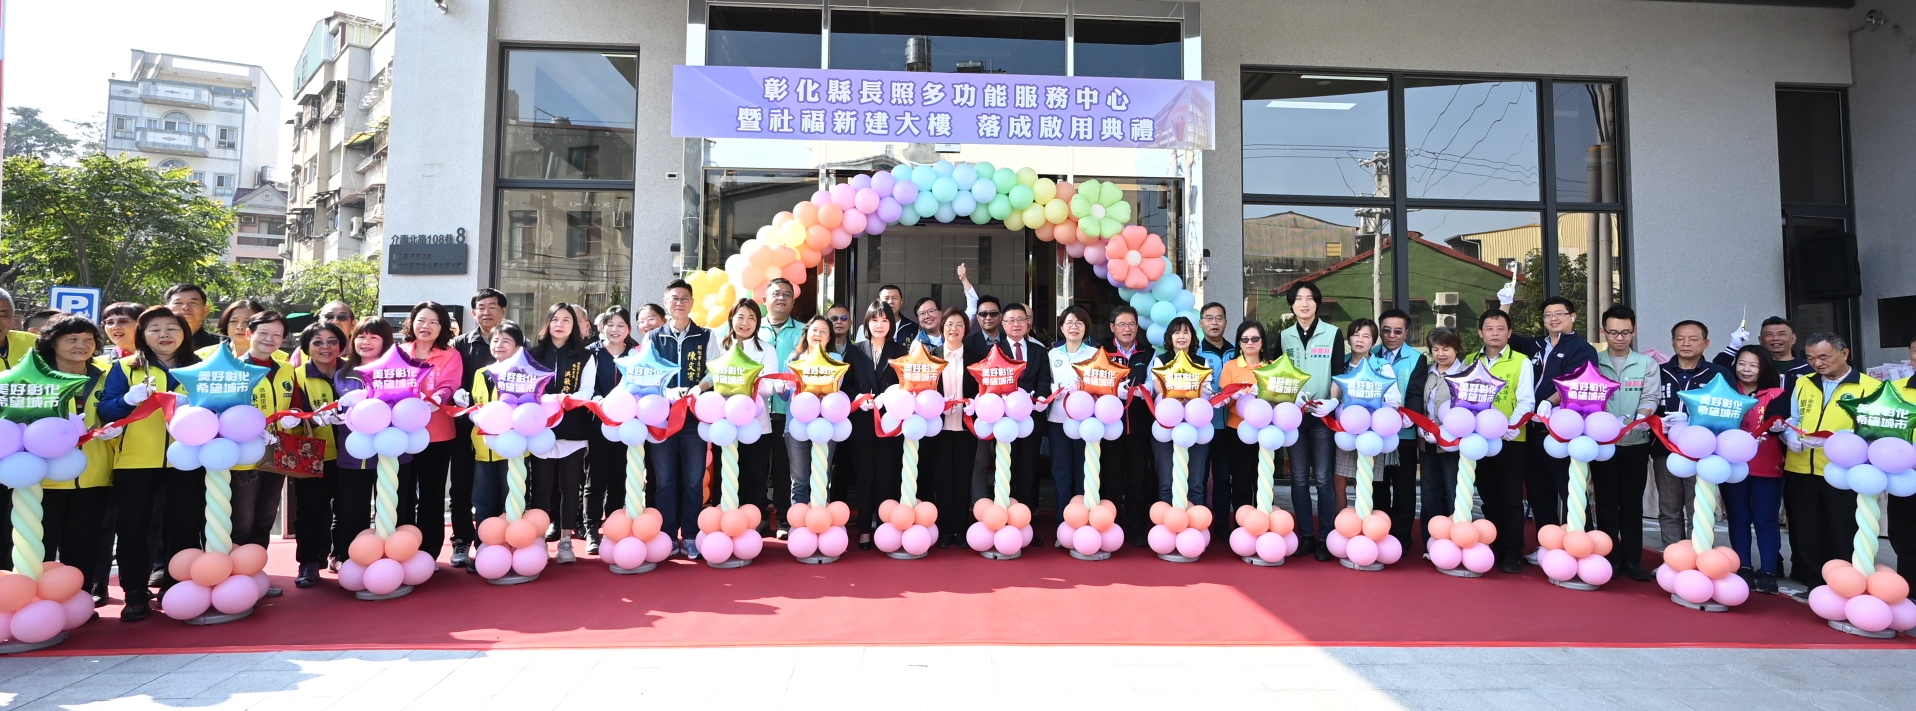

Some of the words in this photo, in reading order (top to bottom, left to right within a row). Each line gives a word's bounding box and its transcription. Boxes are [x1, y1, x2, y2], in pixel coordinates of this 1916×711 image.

[763, 77, 1130, 111] 彰化縣長照多功能服務中心
[737, 106, 953, 137] 暨社福新建大樓
[456, 227, 466, 244] 8
[61, 295, 89, 315] P
[197, 371, 250, 382] 美好彰化
[372, 368, 418, 379] 美好彰化
[981, 367, 1014, 377] 美好彰化
[372, 379, 418, 390] 希望城市
[981, 376, 1014, 386] 希望城市
[1348, 380, 1383, 390] 美好彰化
[1568, 381, 1608, 393] 美好彰化
[196, 382, 249, 394] 希望城市
[1347, 389, 1382, 399] 希望城市
[1459, 382, 1498, 394] 美好彰化
[1458, 391, 1496, 402] 希望城市
[1567, 391, 1607, 401] 希望城市
[1698, 395, 1743, 410] 美好彰化
[1697, 405, 1741, 419] 希望城市
[1855, 414, 1908, 430] 希望城市
